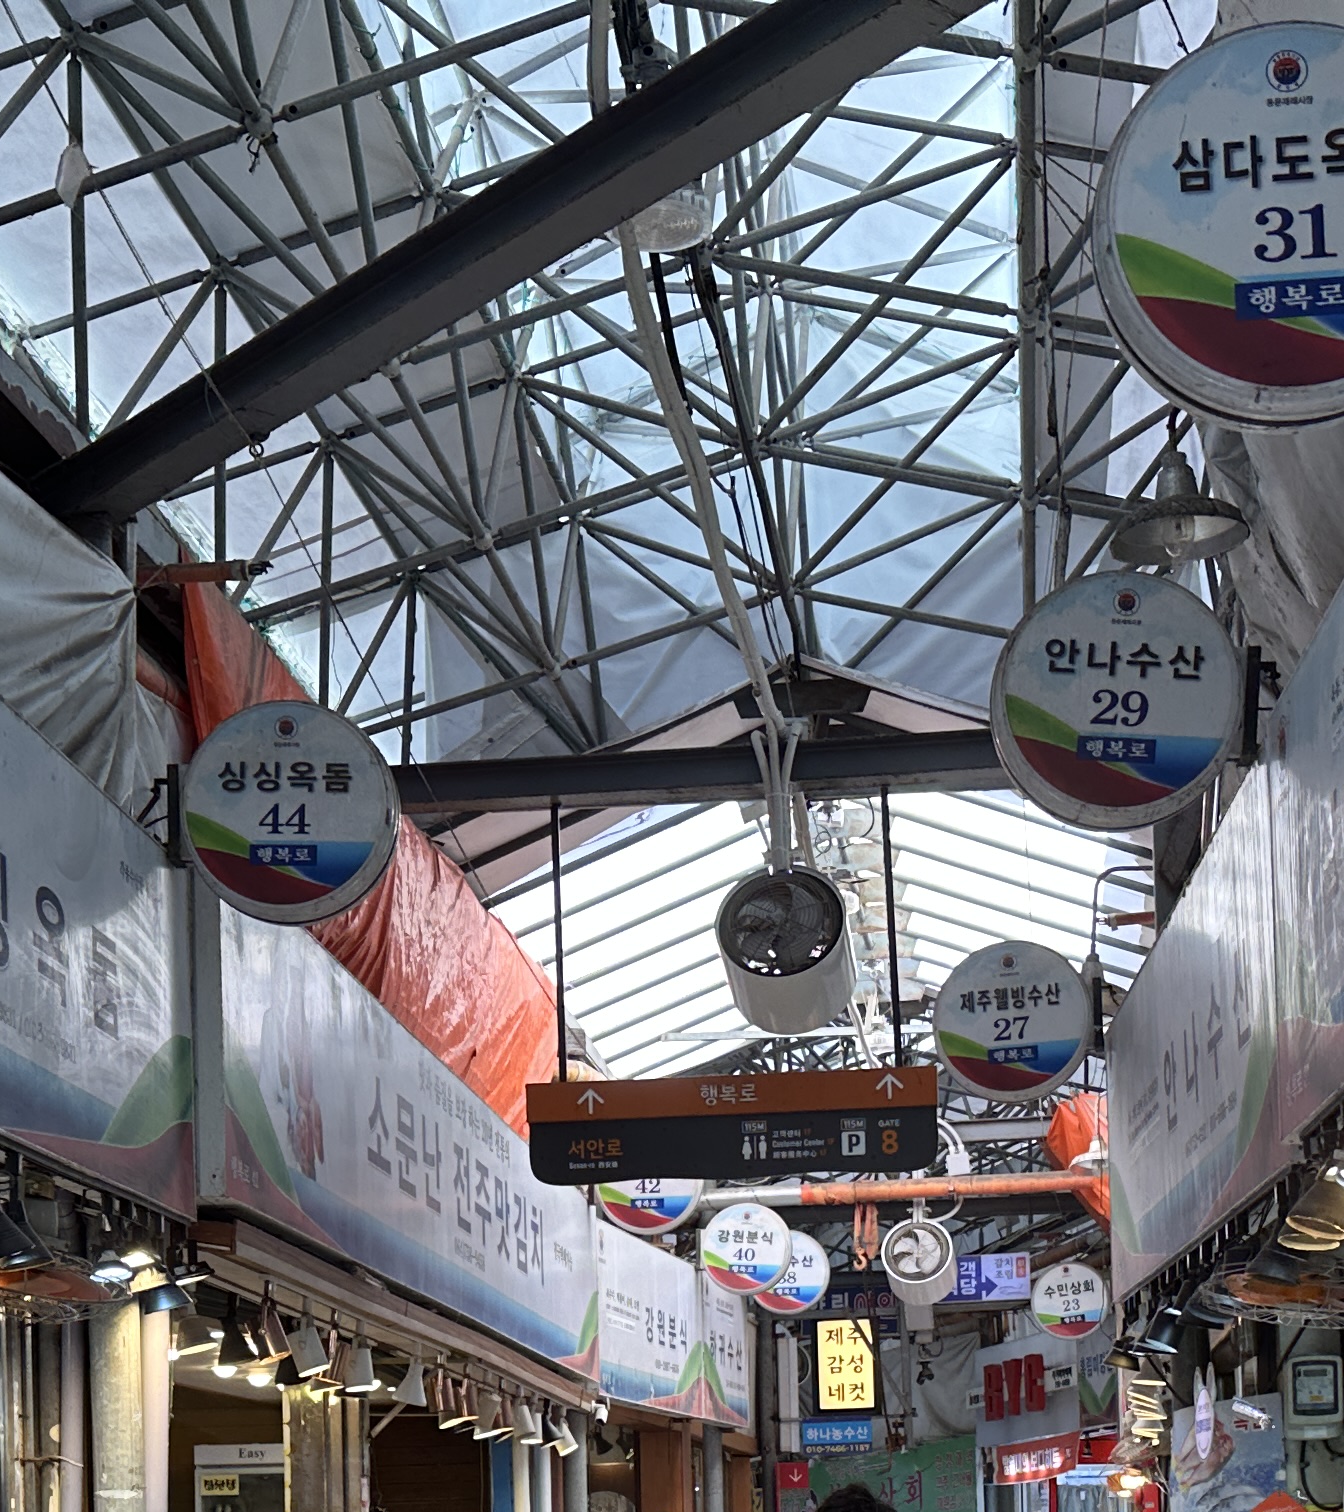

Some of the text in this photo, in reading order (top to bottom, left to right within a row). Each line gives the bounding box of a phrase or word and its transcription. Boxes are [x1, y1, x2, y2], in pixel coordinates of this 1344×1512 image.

[1254, 204, 1337, 262] 31
[1044, 638, 1205, 681] 안나수산
[1089, 689, 1149, 727] 29
[1085, 739, 1149, 758] 행복로
[217, 761, 353, 794] 싱싱옥돔
[258, 803, 312, 835] 44
[256, 847, 312, 863] 행복로
[959, 982, 1062, 1014] 제주웰빙수산
[993, 1015, 1030, 1042] 27
[992, 1048, 1035, 1062] 행복로
[700, 1083, 758, 1106] 행복로
[878, 1119, 900, 1128] GATE
[568, 1138, 623, 1160] 서안로
[881, 1129, 899, 1155] 8
[367, 1076, 545, 1287] 소문난 전주맛김치
[635, 1178, 661, 1194] 42
[717, 1229, 774, 1245] 강원분식
[732, 1247, 756, 1262] 40
[1043, 1278, 1095, 1298] 수민상회
[1062, 1299, 1081, 1312] 23
[646, 1306, 688, 1354] 강원분식
[825, 1326, 861, 1347] 제주
[827, 1354, 864, 1375] 감성
[828, 1382, 866, 1402] 네컷
[984, 1353, 1046, 1422] BYC
[806, 1426, 869, 1441] 하나농수산
[238, 1447, 266, 1460] Easy
